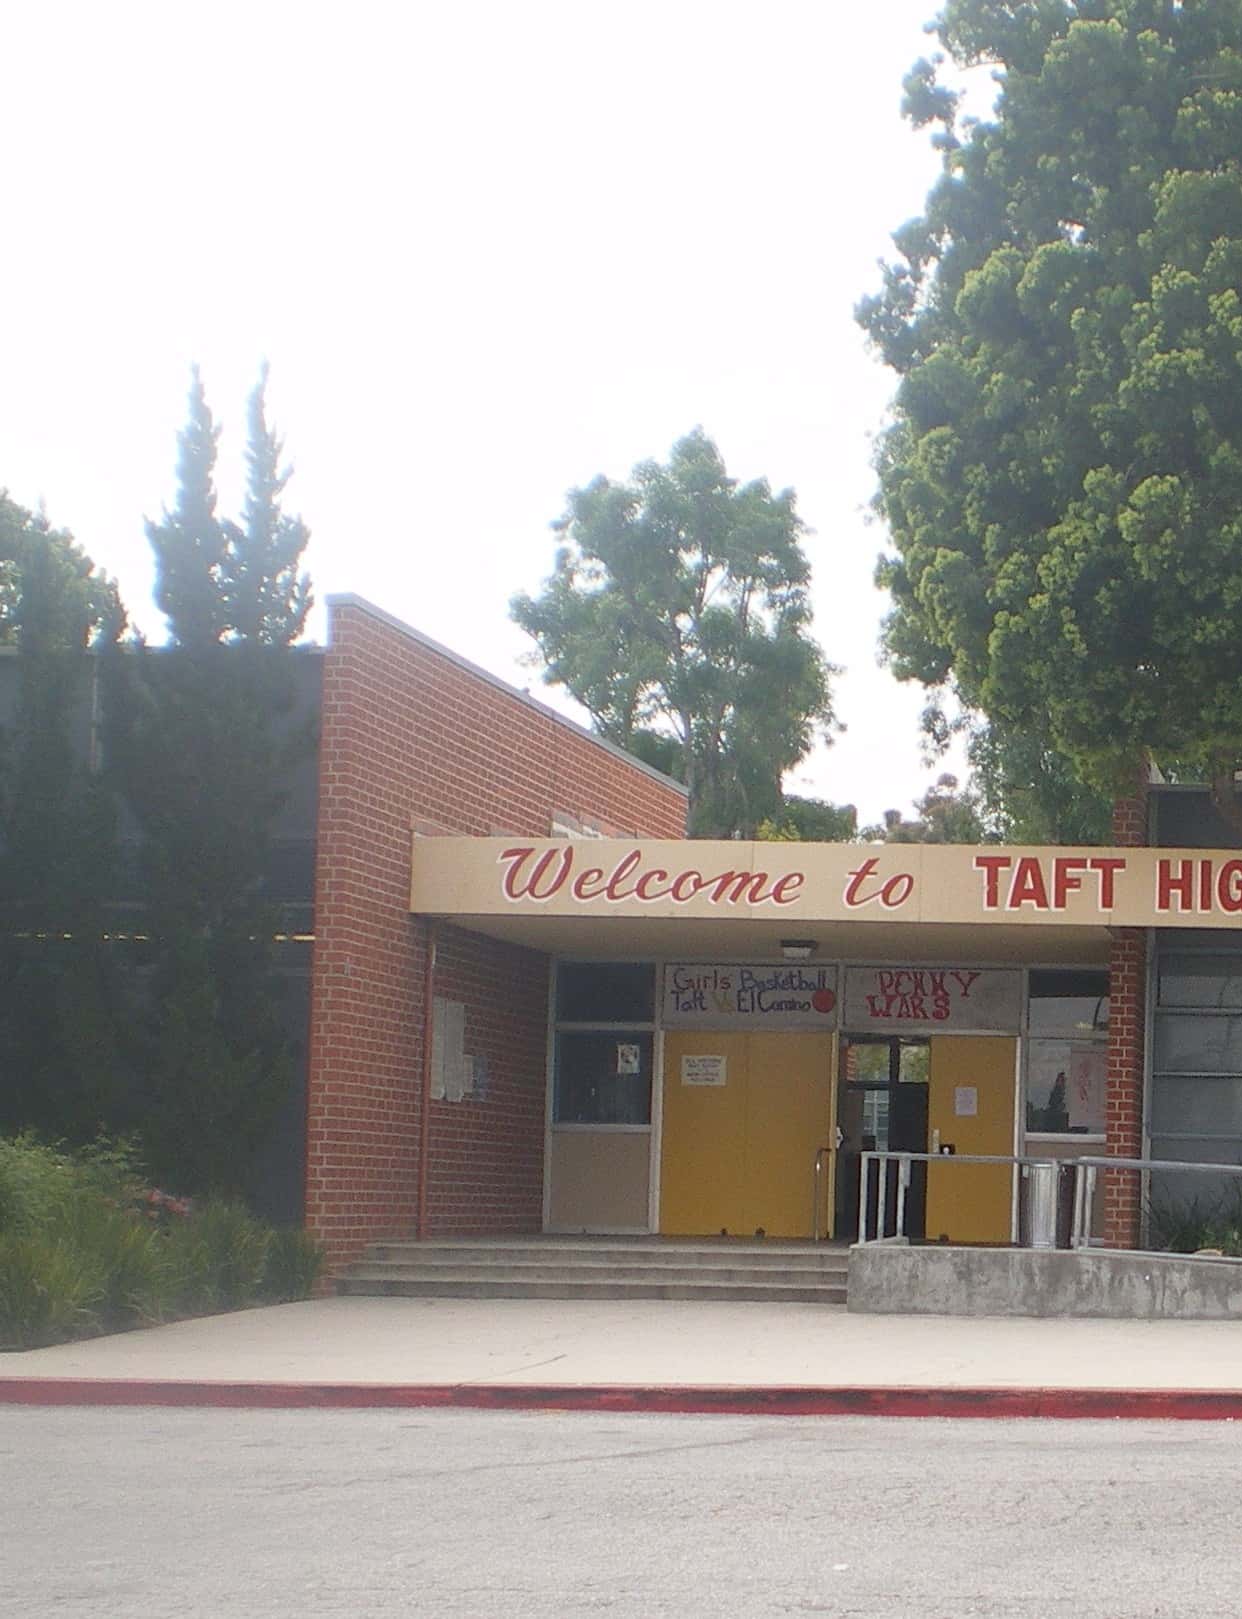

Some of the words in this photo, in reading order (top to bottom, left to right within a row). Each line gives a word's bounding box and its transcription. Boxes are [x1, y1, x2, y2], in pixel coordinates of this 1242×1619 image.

[496, 845, 805, 904] Welcome
[843, 857, 914, 907] to
[973, 856, 1126, 912] TAFT
[739, 969, 826, 992] Basketball
[878, 970, 981, 998] PENNY
[671, 990, 708, 1012] Taft
[866, 994, 951, 1020] WARS
